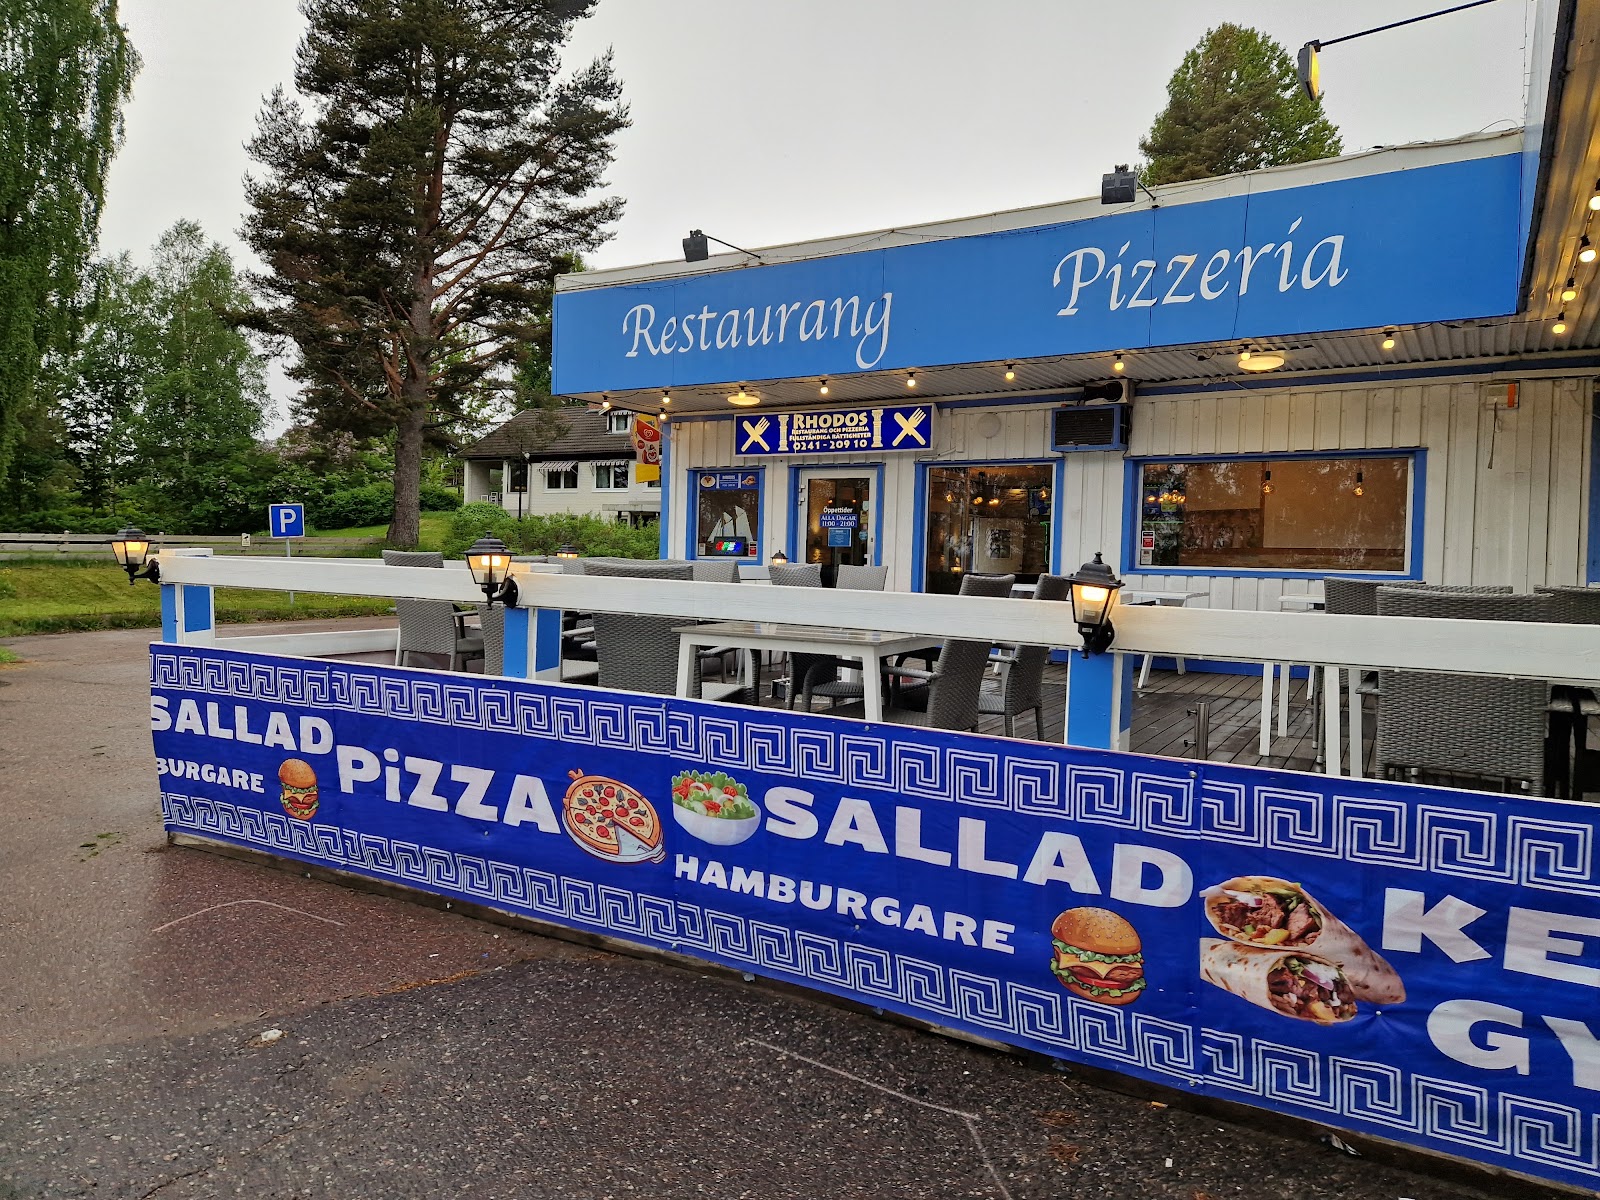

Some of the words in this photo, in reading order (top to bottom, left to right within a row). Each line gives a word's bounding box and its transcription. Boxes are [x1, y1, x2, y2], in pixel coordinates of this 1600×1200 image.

[793, 412, 868, 429] RHODOS
[793, 441, 820, 451] 0241
[829, 440, 850, 449] 209
[854, 439, 868, 448] 10
[280, 508, 297, 533] P
[823, 505, 853, 514] Öppettider
[150, 695, 333, 755] SALLAD
[765, 787, 1193, 908] SALLAD
[676, 854, 1015, 955] HAMBURGARE
